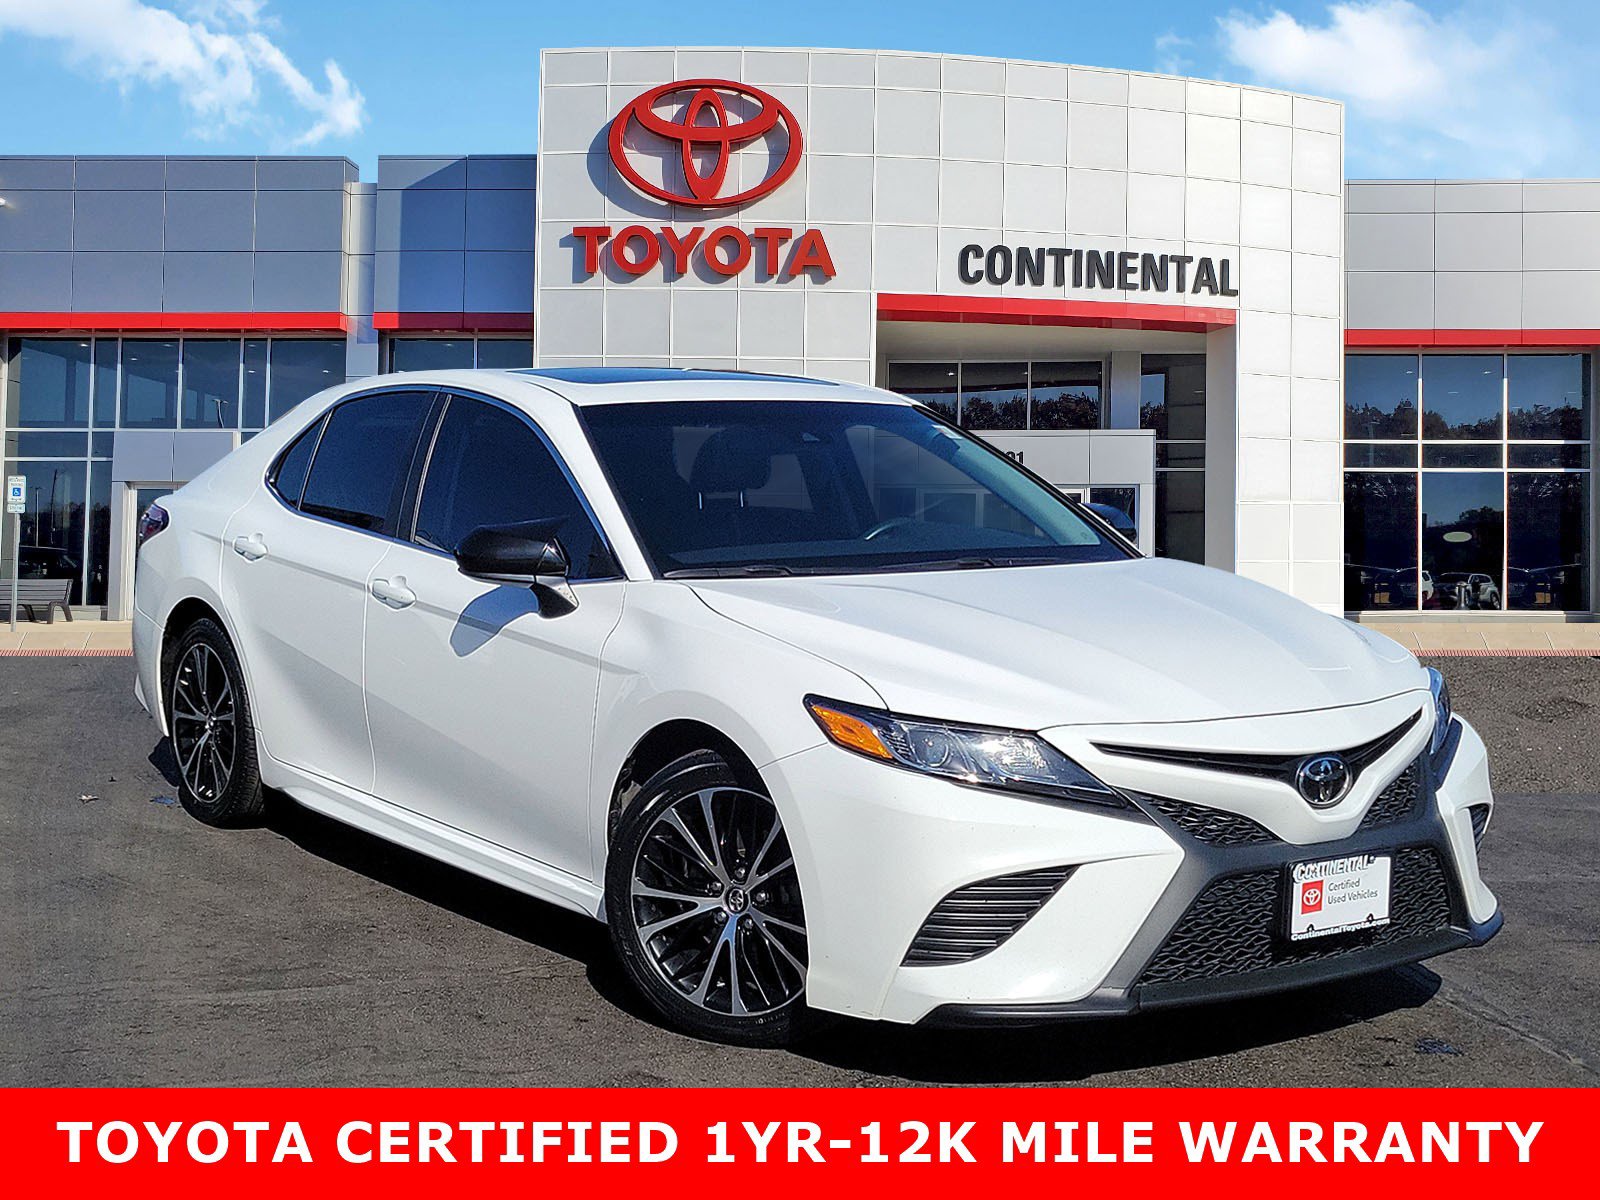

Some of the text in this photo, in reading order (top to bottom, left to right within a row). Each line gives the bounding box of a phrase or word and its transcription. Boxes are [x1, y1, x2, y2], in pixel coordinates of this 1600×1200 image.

[572, 225, 836, 277] TOYOTA
[958, 244, 1239, 297] CONTINENTAL
[1293, 855, 1369, 883] CONTINENTAL
[1328, 879, 1360, 891] Certified
[1328, 889, 1378, 904] Used Vehicles
[1291, 918, 1390, 941] ContinentalToyota.com
